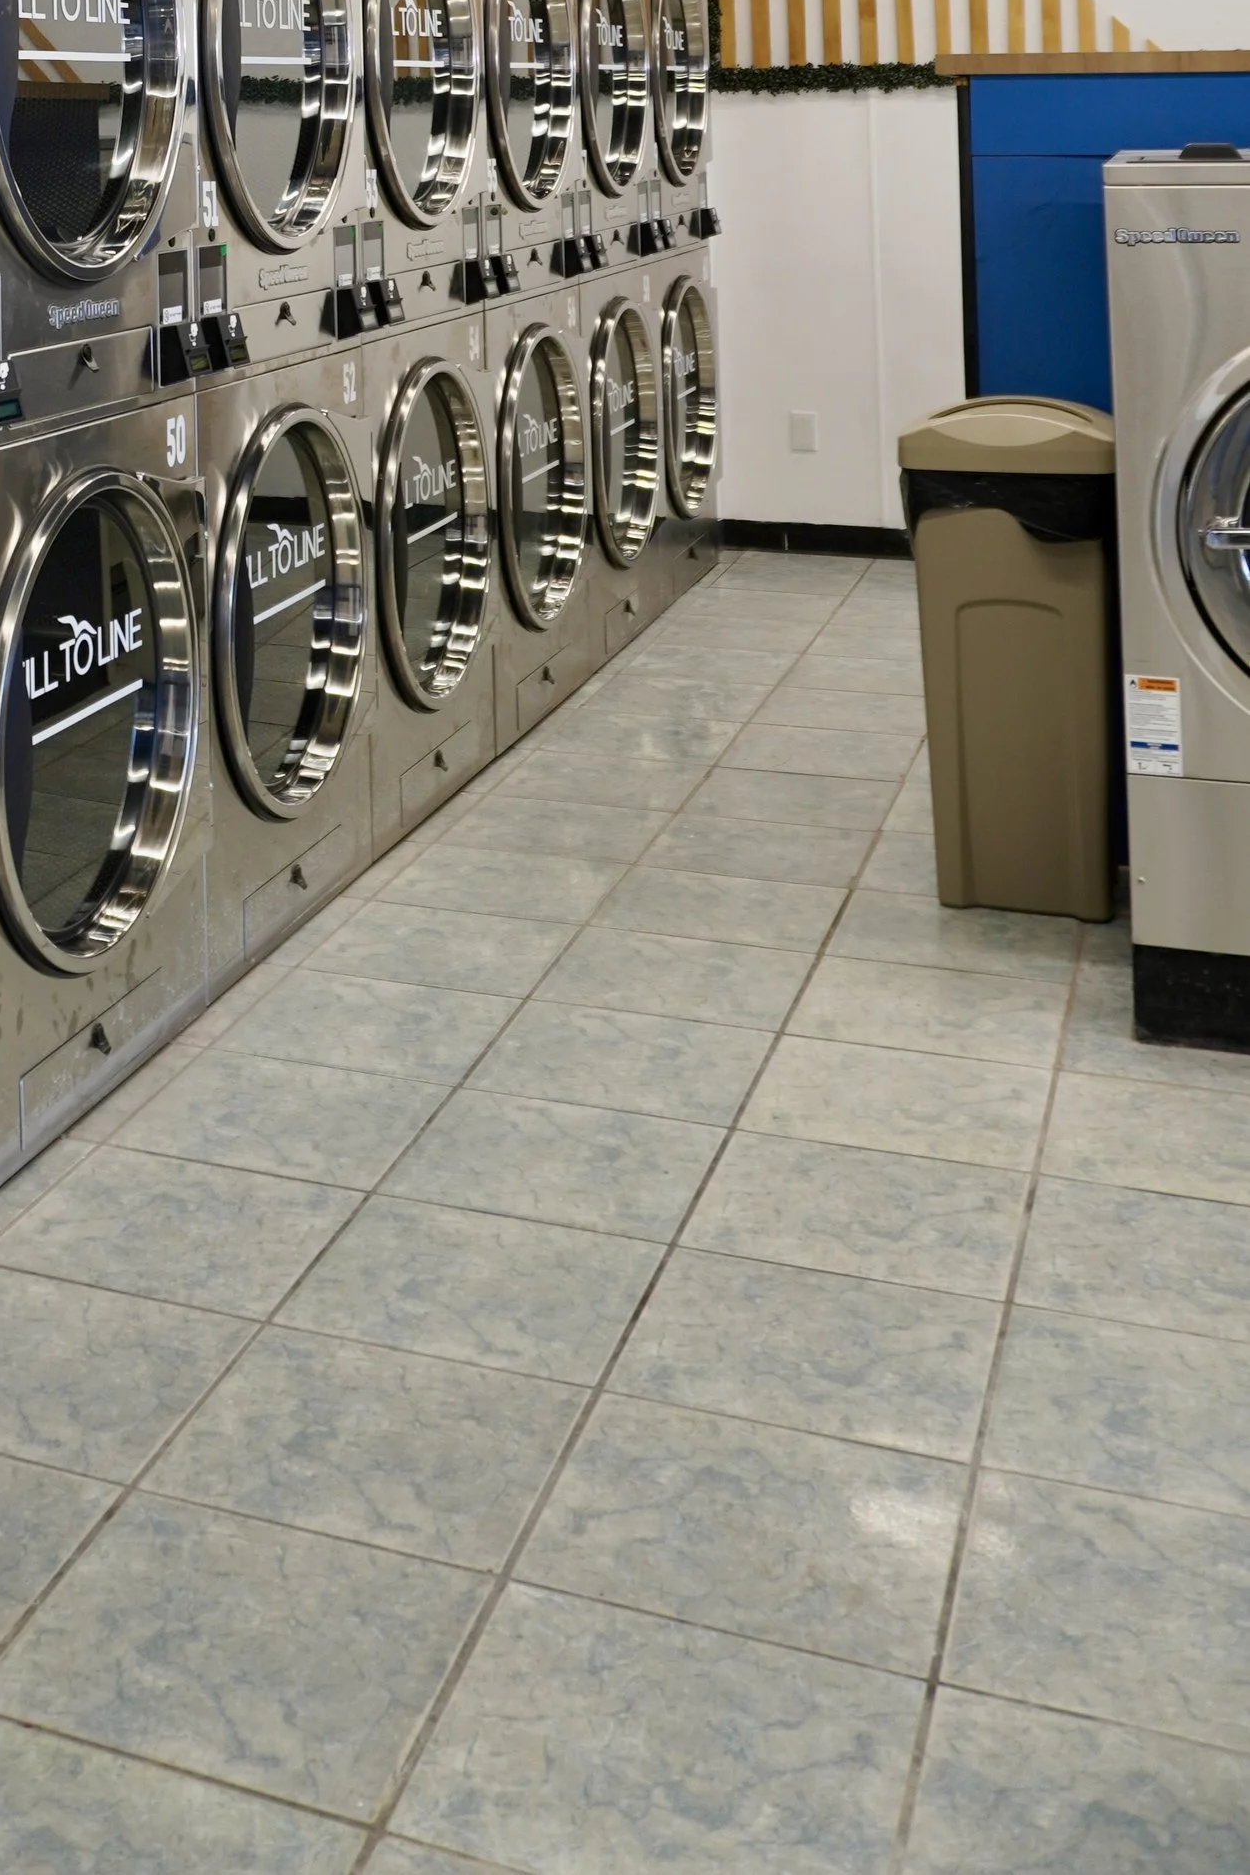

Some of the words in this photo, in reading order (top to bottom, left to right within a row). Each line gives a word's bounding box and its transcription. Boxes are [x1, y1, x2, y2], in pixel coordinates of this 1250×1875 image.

[398, 7, 418, 37] TO
[418, 8, 443, 37] LINE
[203, 181, 218, 227] 51
[343, 361, 356, 404] 52
[167, 415, 186, 467] 50
[413, 471, 430, 504] TO
[432, 459, 456, 496] LINE
[268, 539, 291, 578] TO
[294, 523, 325, 568] LINE
[59, 633, 93, 682] TO
[98, 608, 142, 666] LINE
